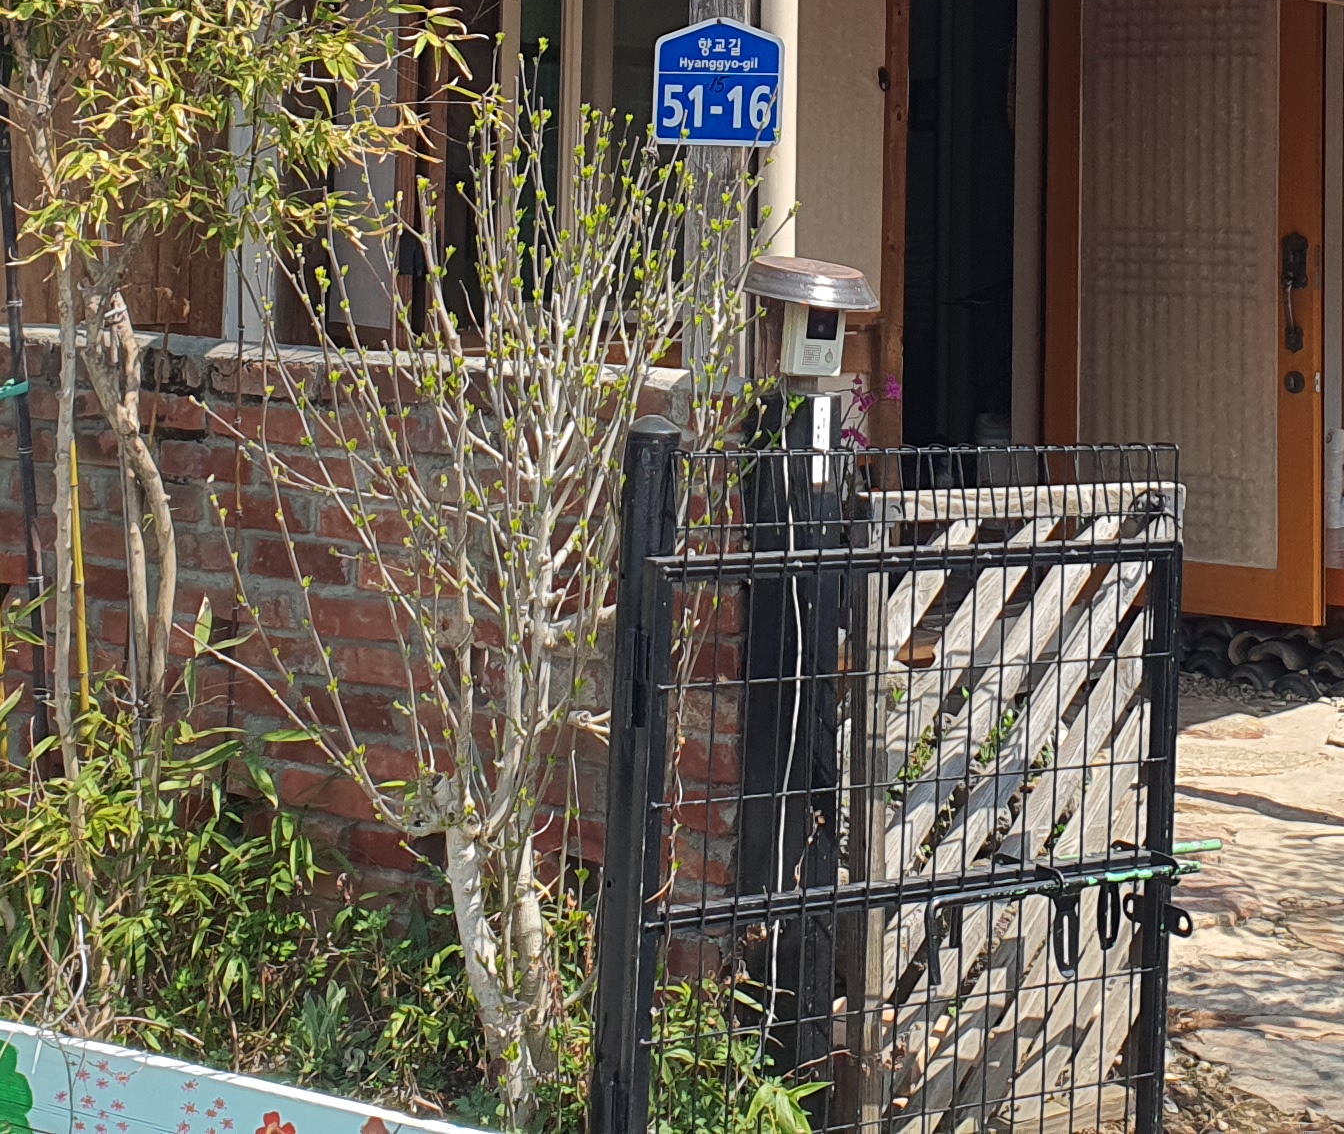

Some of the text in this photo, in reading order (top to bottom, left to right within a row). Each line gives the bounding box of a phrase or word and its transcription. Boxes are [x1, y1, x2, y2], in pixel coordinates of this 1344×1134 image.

[698, 37, 741, 57] 향교길
[679, 56, 759, 72] Hyanggyo-gil
[662, 83, 772, 130] 51-16
